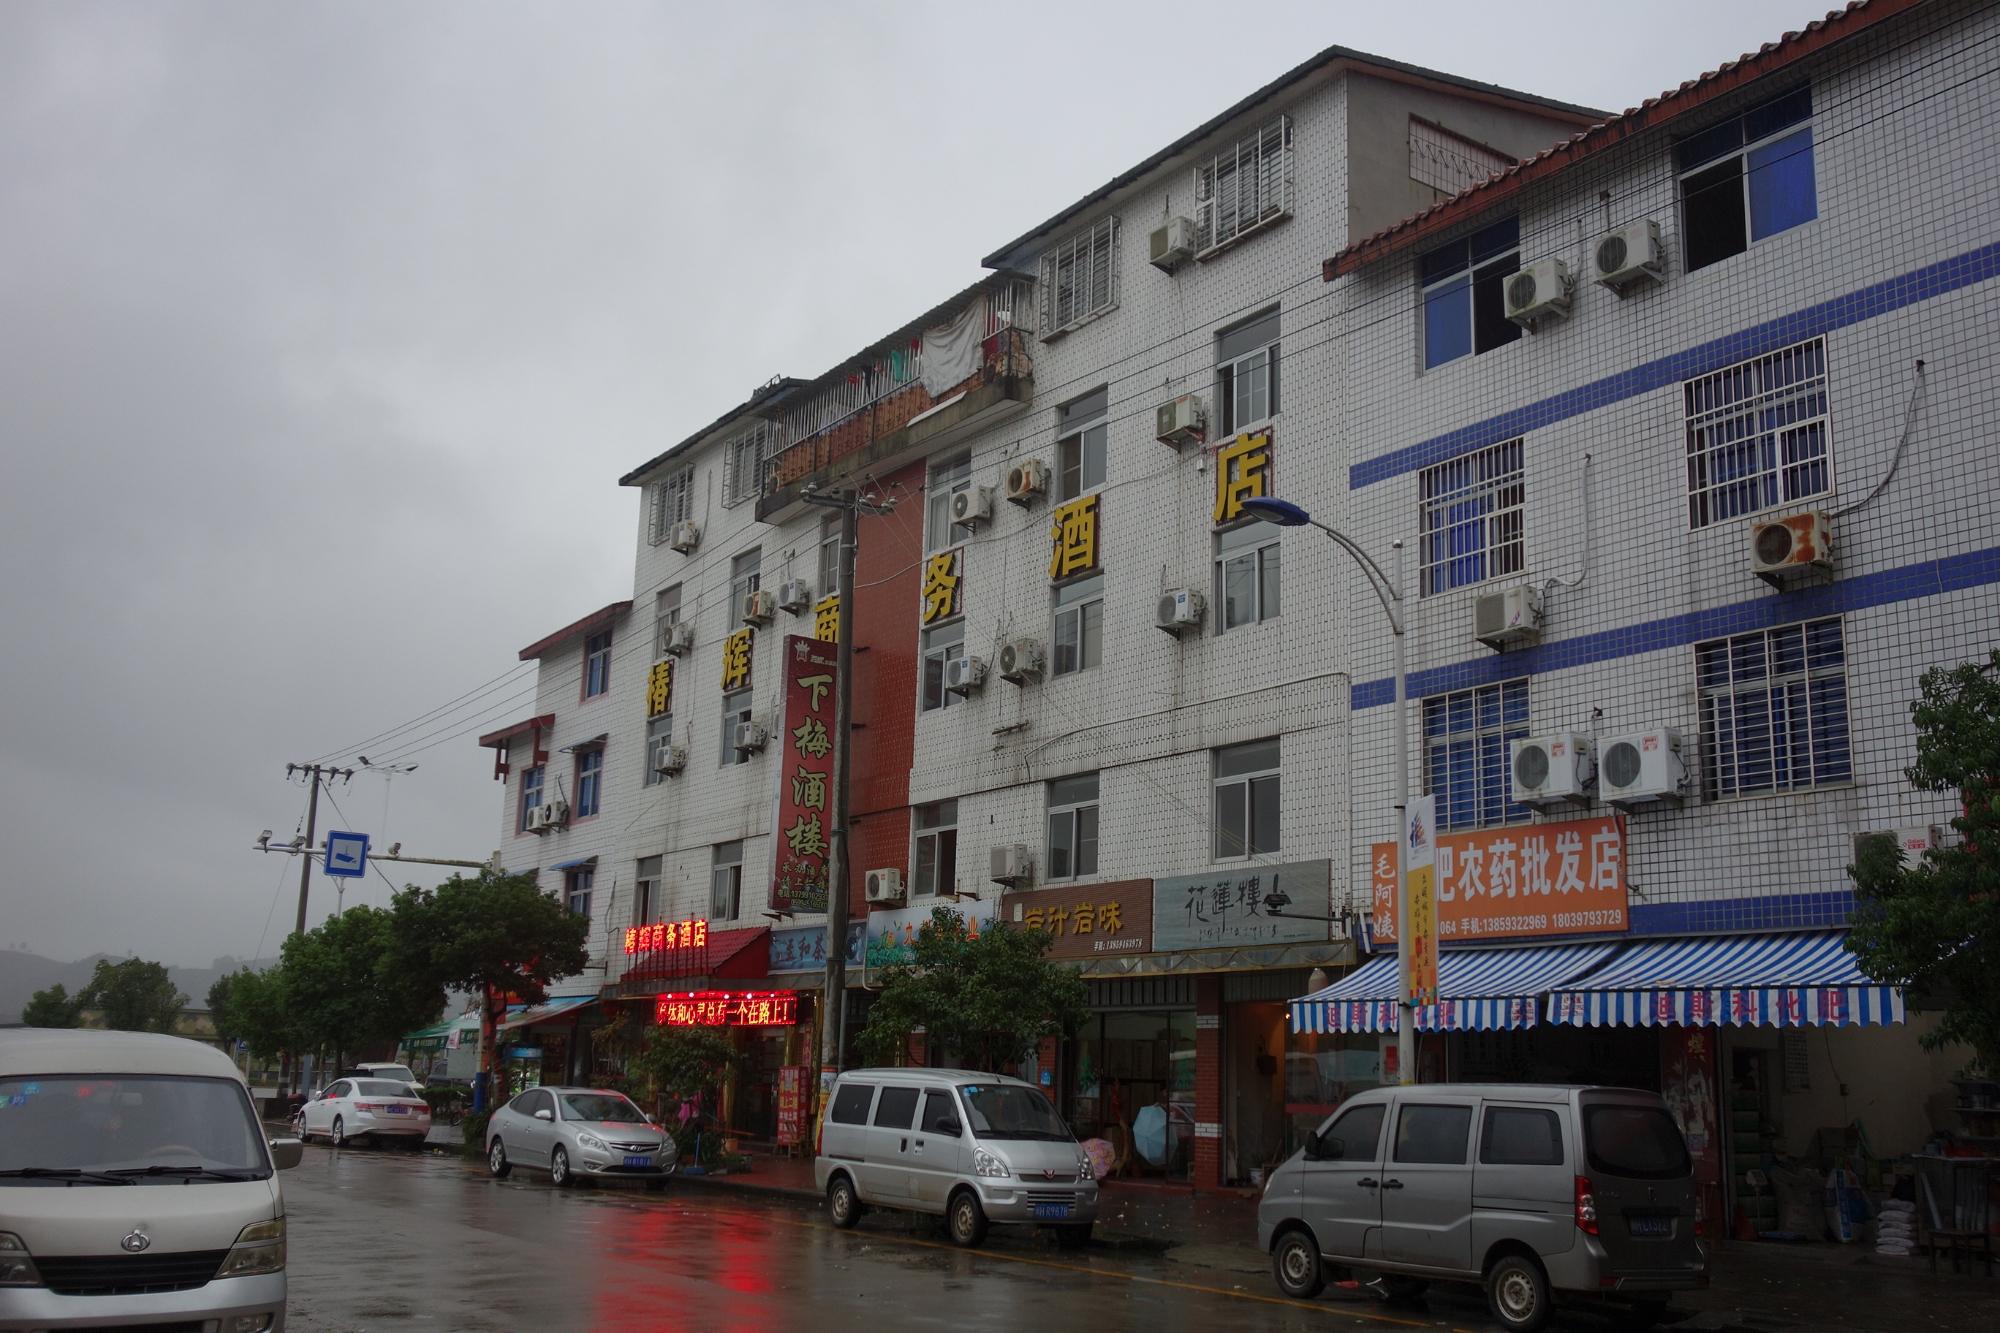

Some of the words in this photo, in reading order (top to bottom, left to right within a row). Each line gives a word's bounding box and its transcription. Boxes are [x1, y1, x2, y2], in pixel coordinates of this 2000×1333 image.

[784, 673, 833, 859] 下梅酒楼
[1373, 853, 1397, 940] 毛阿姨
[1460, 913, 1547, 935] 手机:13859322969
[1552, 909, 1622, 928] 18039793729
[1656, 991, 1846, 1021] 迪斯科化肥
